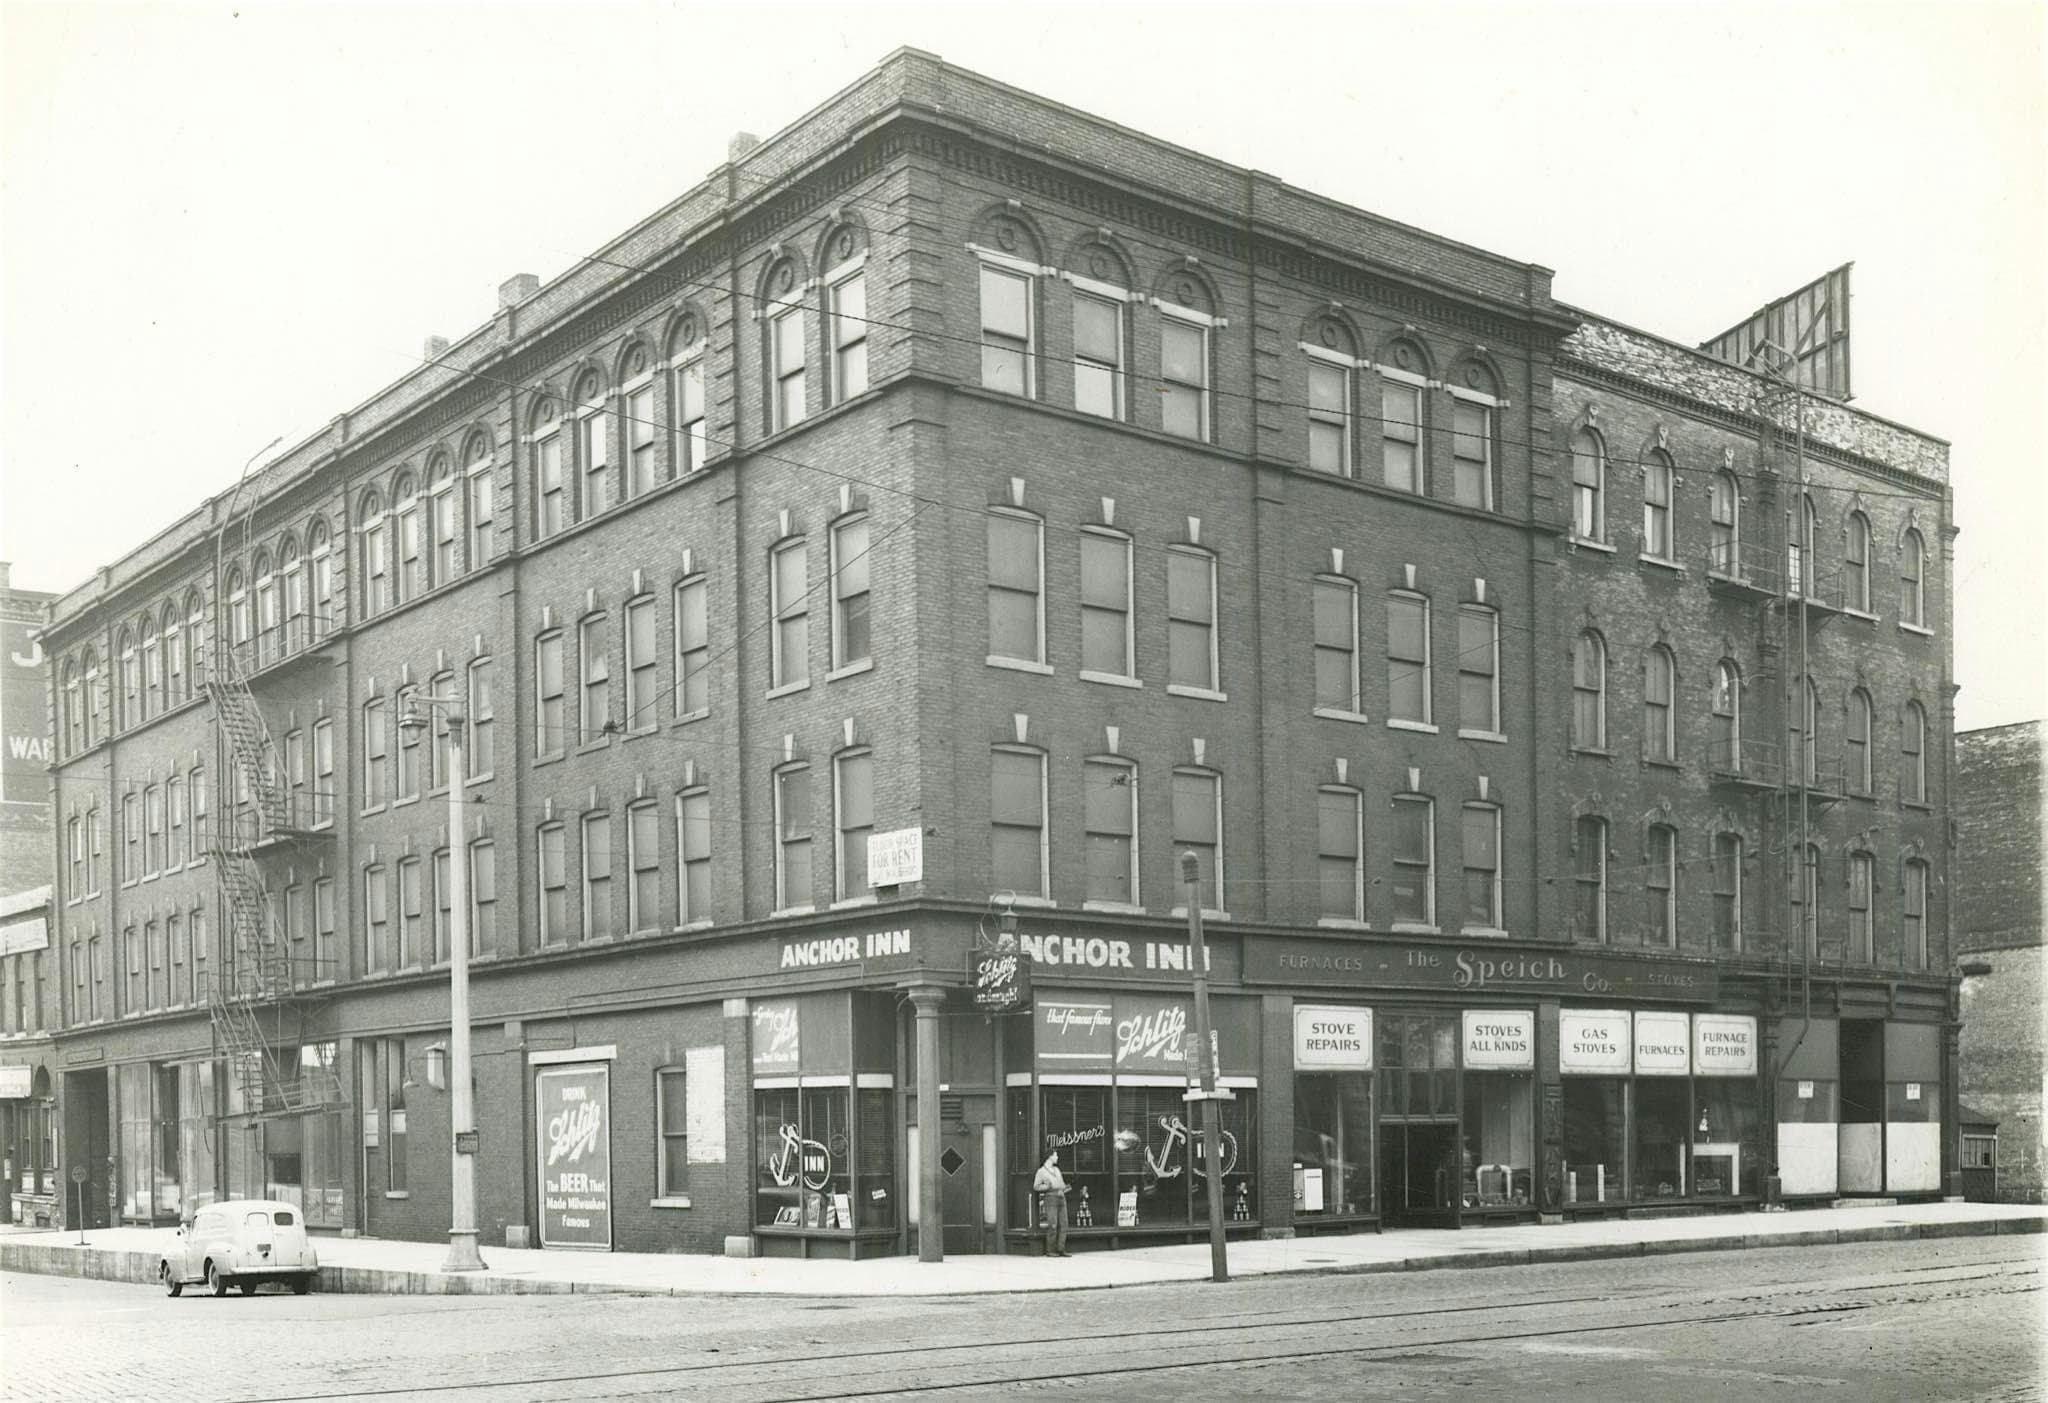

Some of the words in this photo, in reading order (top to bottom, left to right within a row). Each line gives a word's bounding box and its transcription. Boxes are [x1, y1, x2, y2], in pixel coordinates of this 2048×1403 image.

[872, 851, 889, 868] FOR
[891, 846, 918, 866] RENT
[781, 936, 861, 968] ANCHOR
[866, 929, 911, 958] INN
[977, 955, 1017, 988] Schlitz
[1279, 955, 1362, 970] FURNACES
[1406, 951, 1441, 967] The
[1453, 950, 1567, 987] Speich
[1583, 971, 1612, 992] Co.
[1649, 974, 1695, 987] STOVES
[1046, 1008, 1067, 1024] that
[1062, 1008, 1092, 1035] famous
[1116, 1006, 1186, 1064] Schlitz
[1312, 1023, 1356, 1035] STOVE
[1475, 1025, 1522, 1037] STOVES
[1582, 1028, 1608, 1040] GAS
[1703, 1032, 1748, 1043] FURNACE
[1306, 1039, 1361, 1051] REPAIRS
[1470, 1041, 1491, 1052] ALL
[1494, 1041, 1527, 1052] KINDS
[1573, 1043, 1617, 1054] STOVES
[1639, 1045, 1686, 1056] FURNACES
[1705, 1046, 1746, 1057] REPAIRS
[547, 1099, 601, 1166] Schlitz
[804, 1155, 825, 1173] INN
[546, 1180, 560, 1193] The
[560, 1172, 589, 1193] BEER
[589, 1179, 606, 1193] That
[546, 1196, 567, 1210] Made
